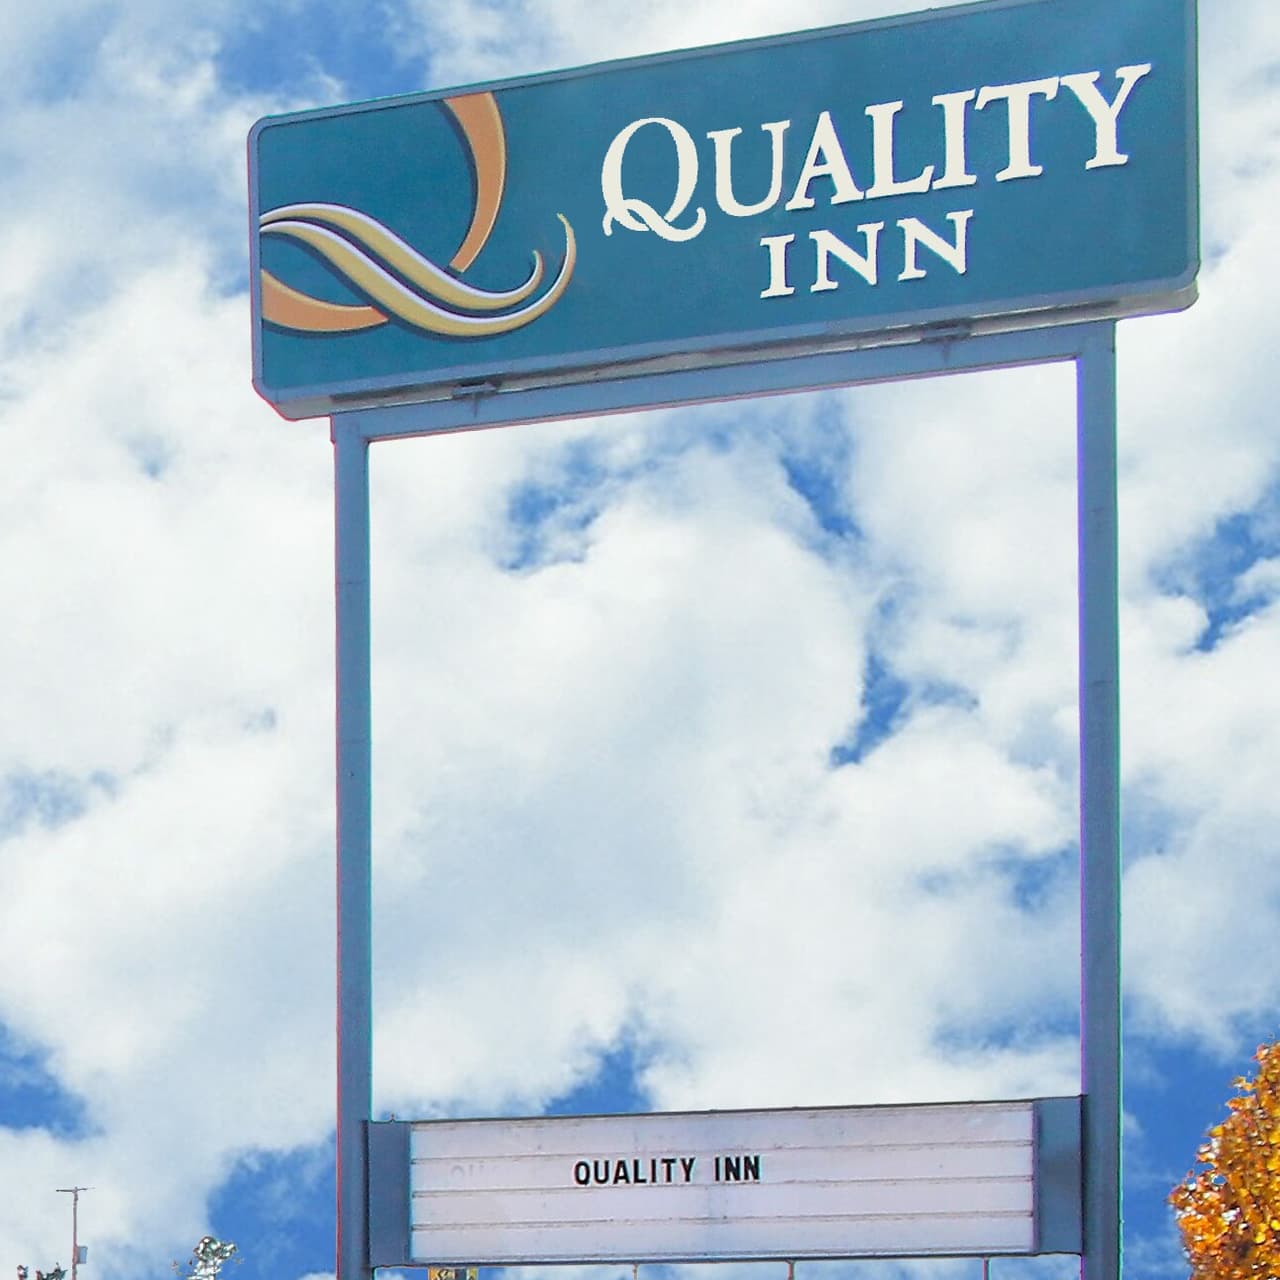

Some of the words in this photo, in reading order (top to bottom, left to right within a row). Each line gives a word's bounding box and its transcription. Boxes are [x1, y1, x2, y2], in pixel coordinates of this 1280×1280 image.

[601, 63, 1152, 242] QUALITY
[759, 209, 973, 298] INN
[573, 1156, 695, 1185] QUALITY
[715, 1155, 760, 1182] INN
